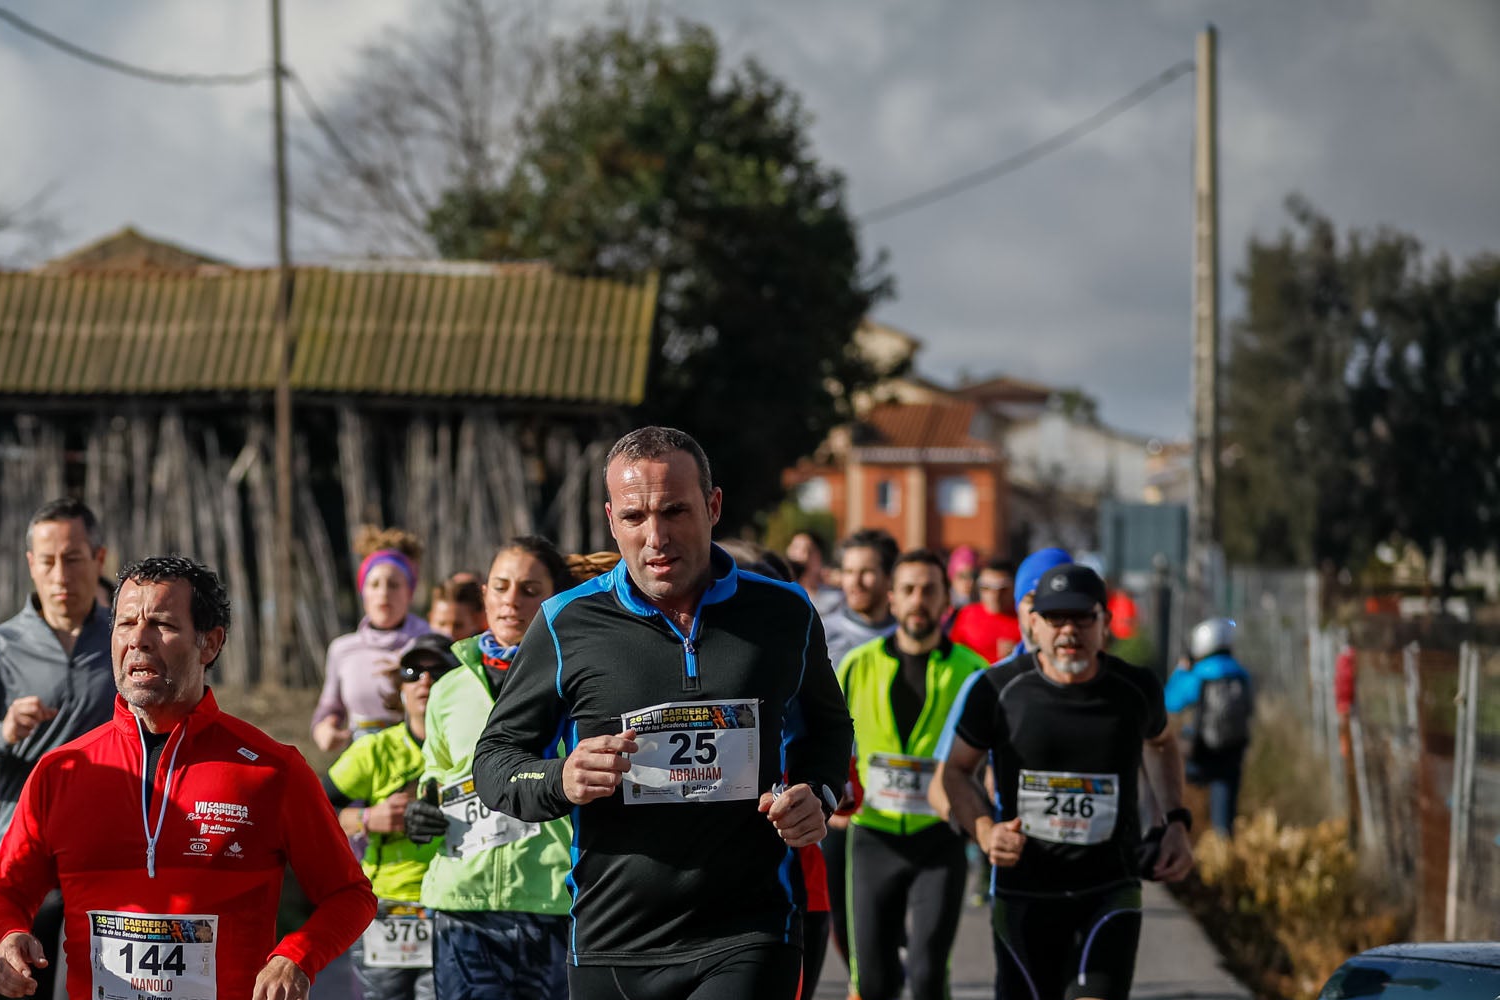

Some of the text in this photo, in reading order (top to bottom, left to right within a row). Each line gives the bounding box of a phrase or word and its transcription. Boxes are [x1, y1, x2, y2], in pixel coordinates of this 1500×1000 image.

[630, 707, 709, 724] 26 VII CARRERA
[663, 715, 709, 723] POPULAR
[668, 732, 717, 766] 25
[669, 768, 722, 782] ABRAHAM
[195, 801, 248, 813] VII CARRERA
[207, 808, 248, 818] POPULAR
[1044, 796, 1094, 818] 246
[210, 824, 235, 833] olimpo
[96, 916, 107, 924] 26
[115, 917, 124, 930] VII
[124, 918, 168, 928] CARRERA
[124, 926, 168, 934] POPULAR
[122, 932, 147, 940] Secaderos
[384, 920, 428, 942] 376
[120, 942, 186, 976] 144
[130, 978, 173, 992] MANOLO
